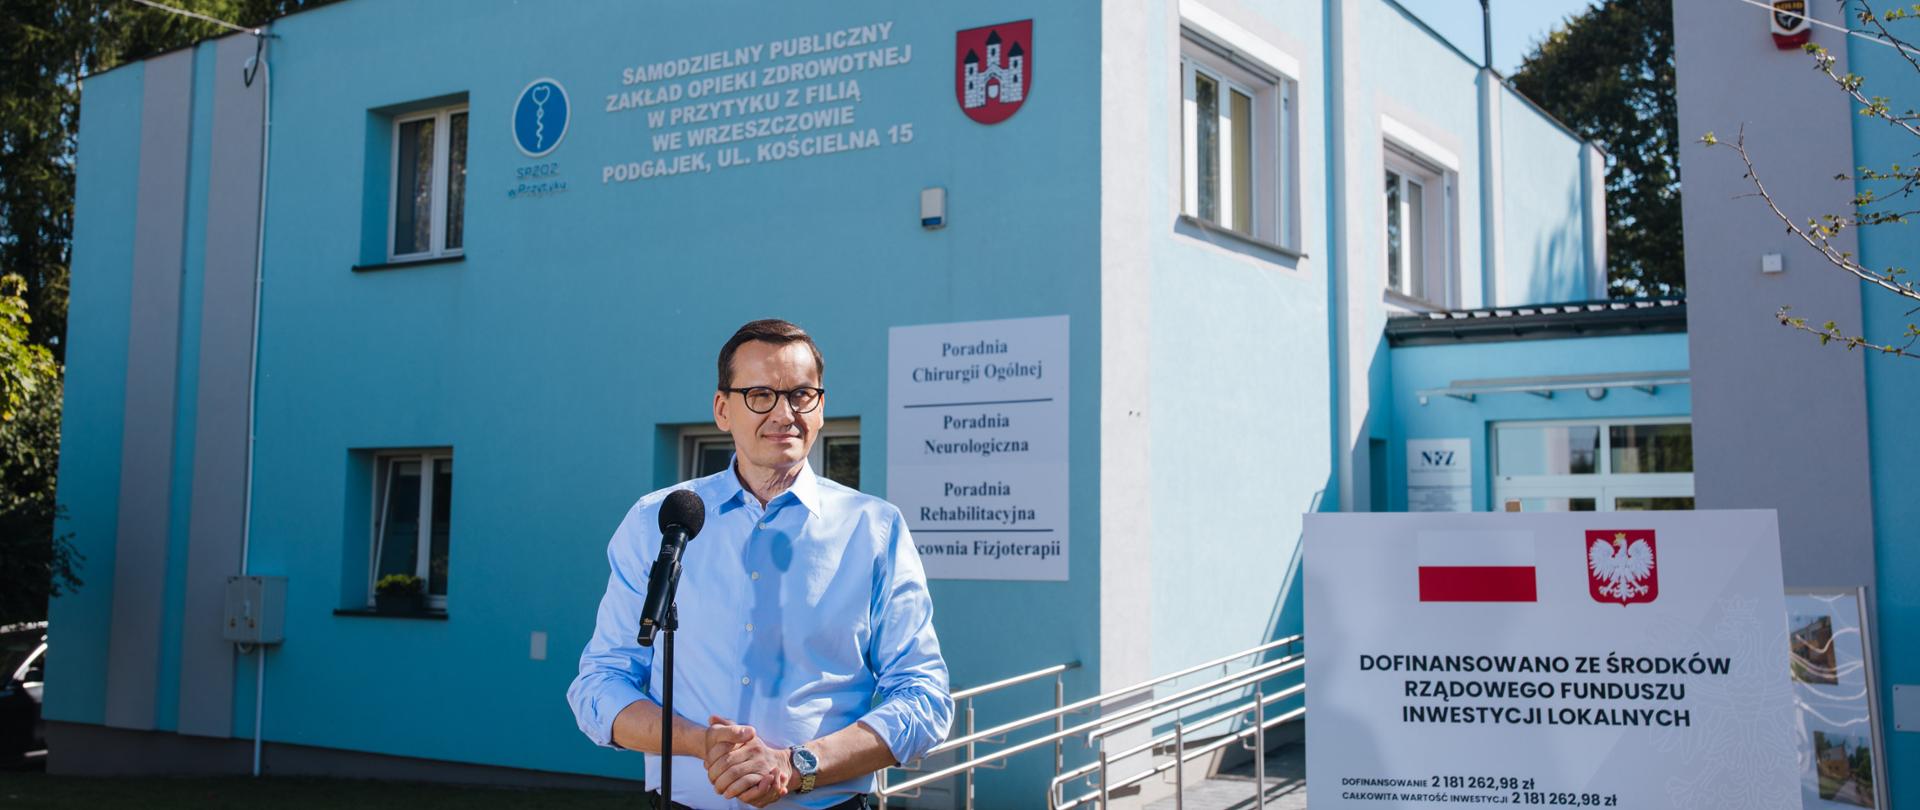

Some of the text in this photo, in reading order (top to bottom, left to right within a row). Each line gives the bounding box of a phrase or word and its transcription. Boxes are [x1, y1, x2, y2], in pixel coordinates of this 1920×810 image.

[622, 21, 893, 86] SAMODZIELNY PUBLICZNY
[606, 44, 912, 113] ZAKŁAD OPIEKI ZDROWOTNEJ
[647, 79, 861, 129] W PRZYTYKU Z FILIĄ
[652, 105, 855, 152] WE WRZESZCZOWIE
[602, 122, 914, 183] PODGAJEK, UL. KOŚCIELNA 15
[941, 340, 1008, 357] Poradnia
[912, 361, 1043, 383] Chirurgii Ogólnej
[943, 414, 1010, 430] Poradnia
[924, 440, 1030, 457] Neurologiczna
[1421, 450, 1455, 467] NFZ
[944, 482, 1011, 497] Poradnia
[920, 506, 1036, 524] Rehabilitacyjna
[916, 541, 1061, 560] cownia Fizjoterapii
[1359, 652, 1731, 676] DOFINANSOWANO ZE ŚRODKÓW
[1404, 680, 1686, 702] RZĄDOWEGO FUNDUSZU
[1402, 706, 1691, 727] INWESTYCJI LOKALNYCH
[1341, 776, 1535, 791] DOFINANSOWANIE 2 181 262,98 zł
[1342, 791, 1618, 807] CAŁKOWITA WARTOŚĆ INWESTYCJI 2 181 262,98 zł
